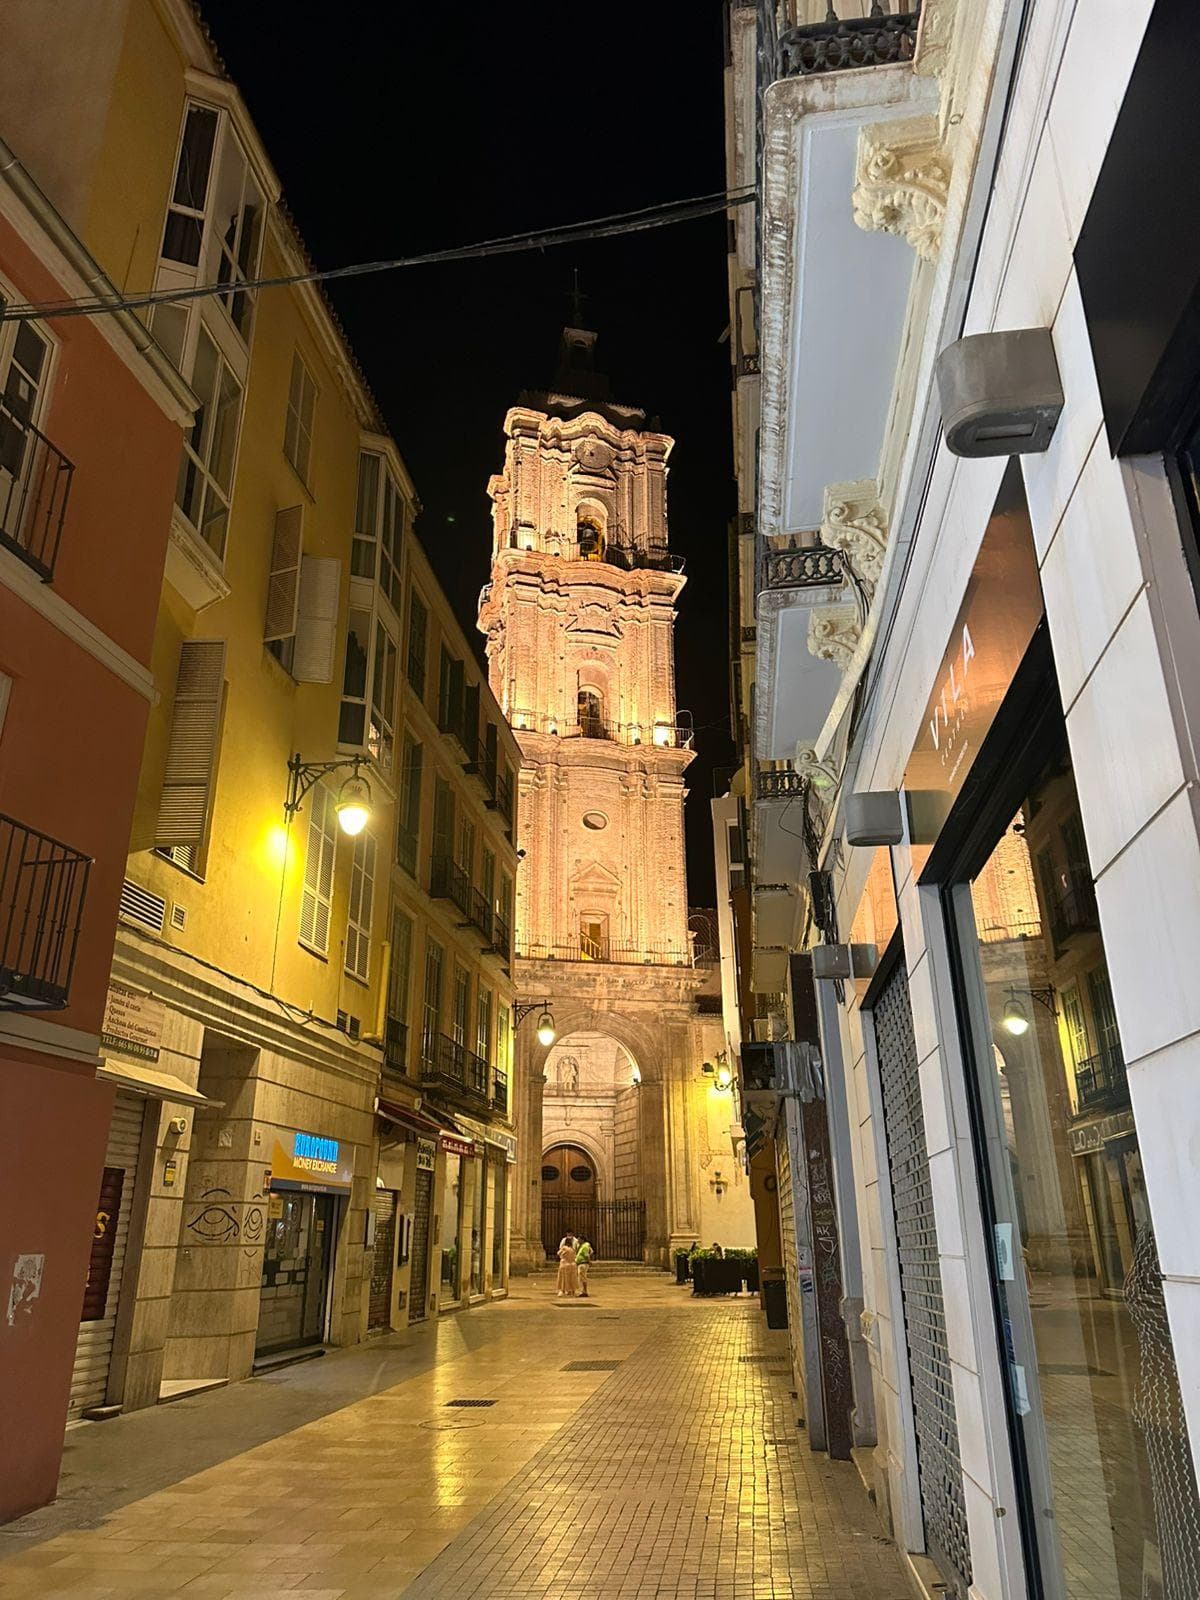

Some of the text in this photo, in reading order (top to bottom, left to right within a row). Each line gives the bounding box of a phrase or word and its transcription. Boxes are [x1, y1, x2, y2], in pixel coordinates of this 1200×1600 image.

[930, 624, 975, 750] VILA
[293, 1157, 338, 1174] MONEY EXCHANGE
